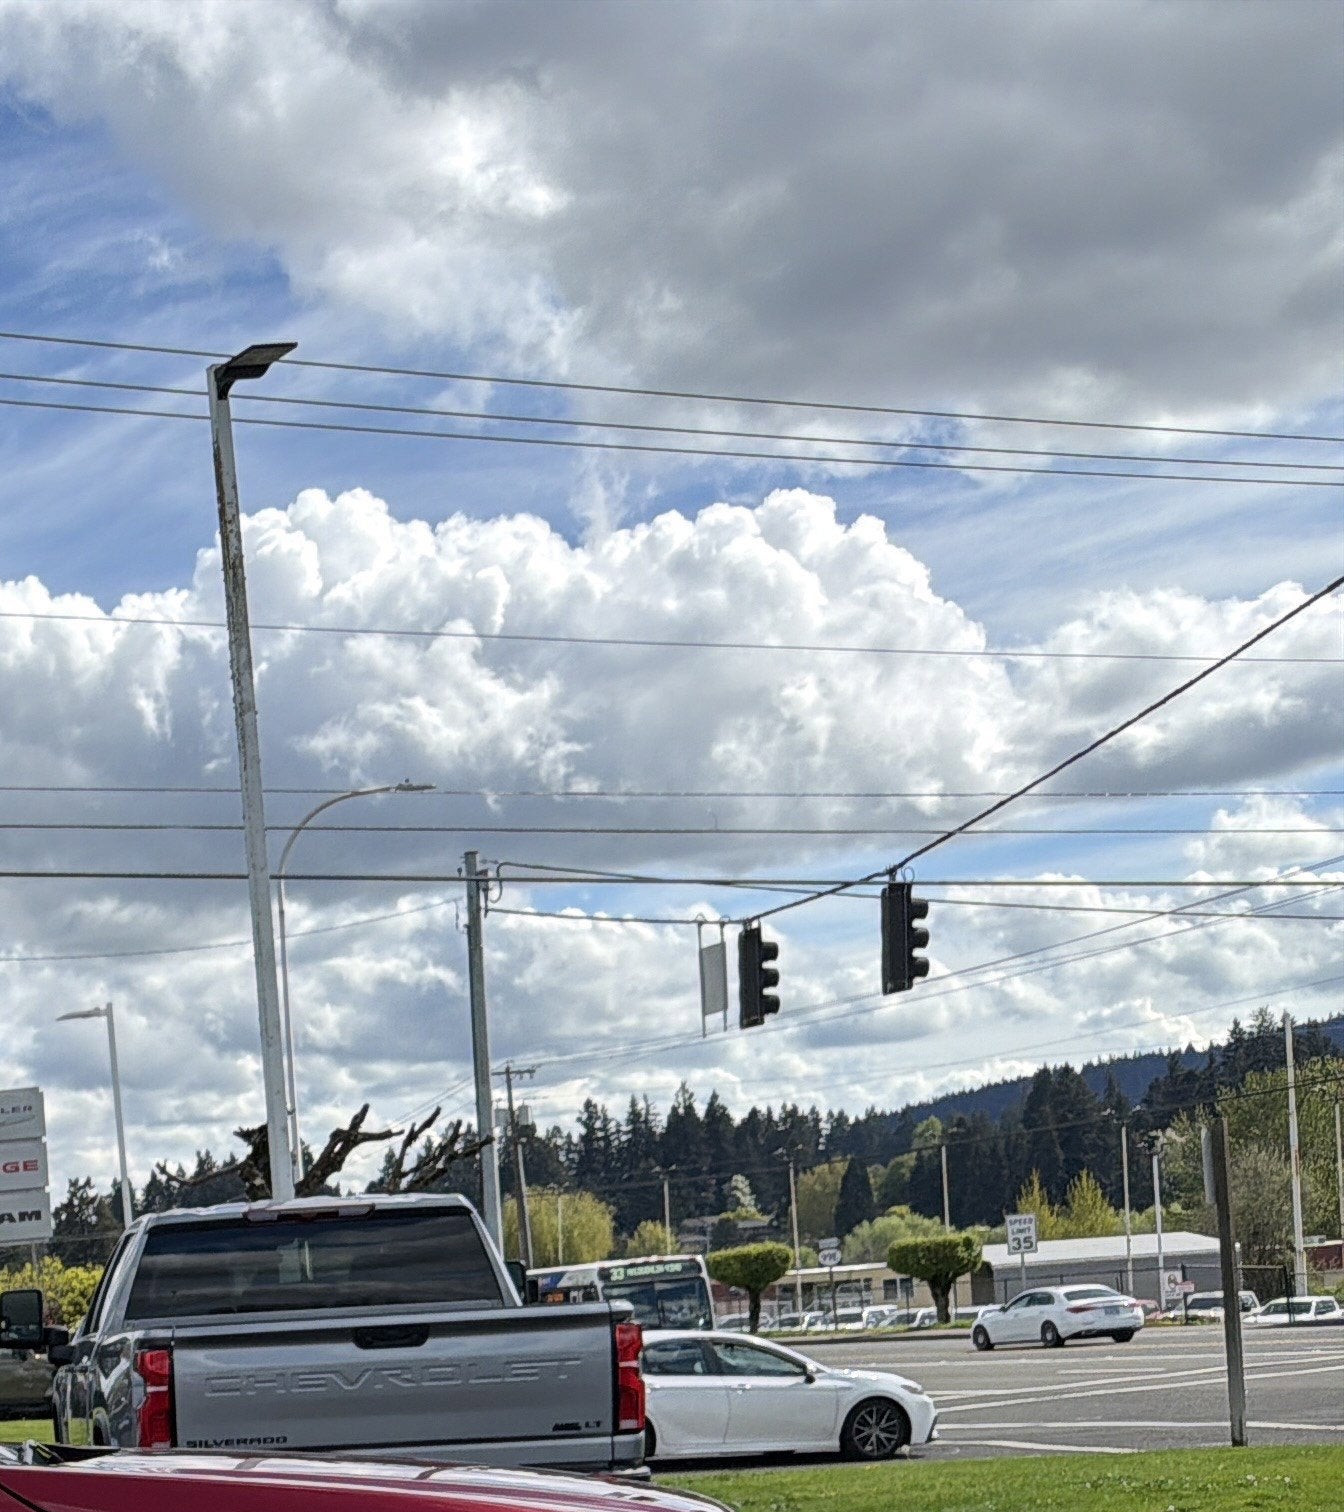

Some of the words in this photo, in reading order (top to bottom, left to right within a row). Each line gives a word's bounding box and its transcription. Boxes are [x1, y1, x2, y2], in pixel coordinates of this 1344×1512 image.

[1012, 1236, 1034, 1250] 35
[205, 1357, 582, 1398] CHEVROLET
[584, 1420, 603, 1429] LT
[186, 1435, 288, 1448] SILVERADO
